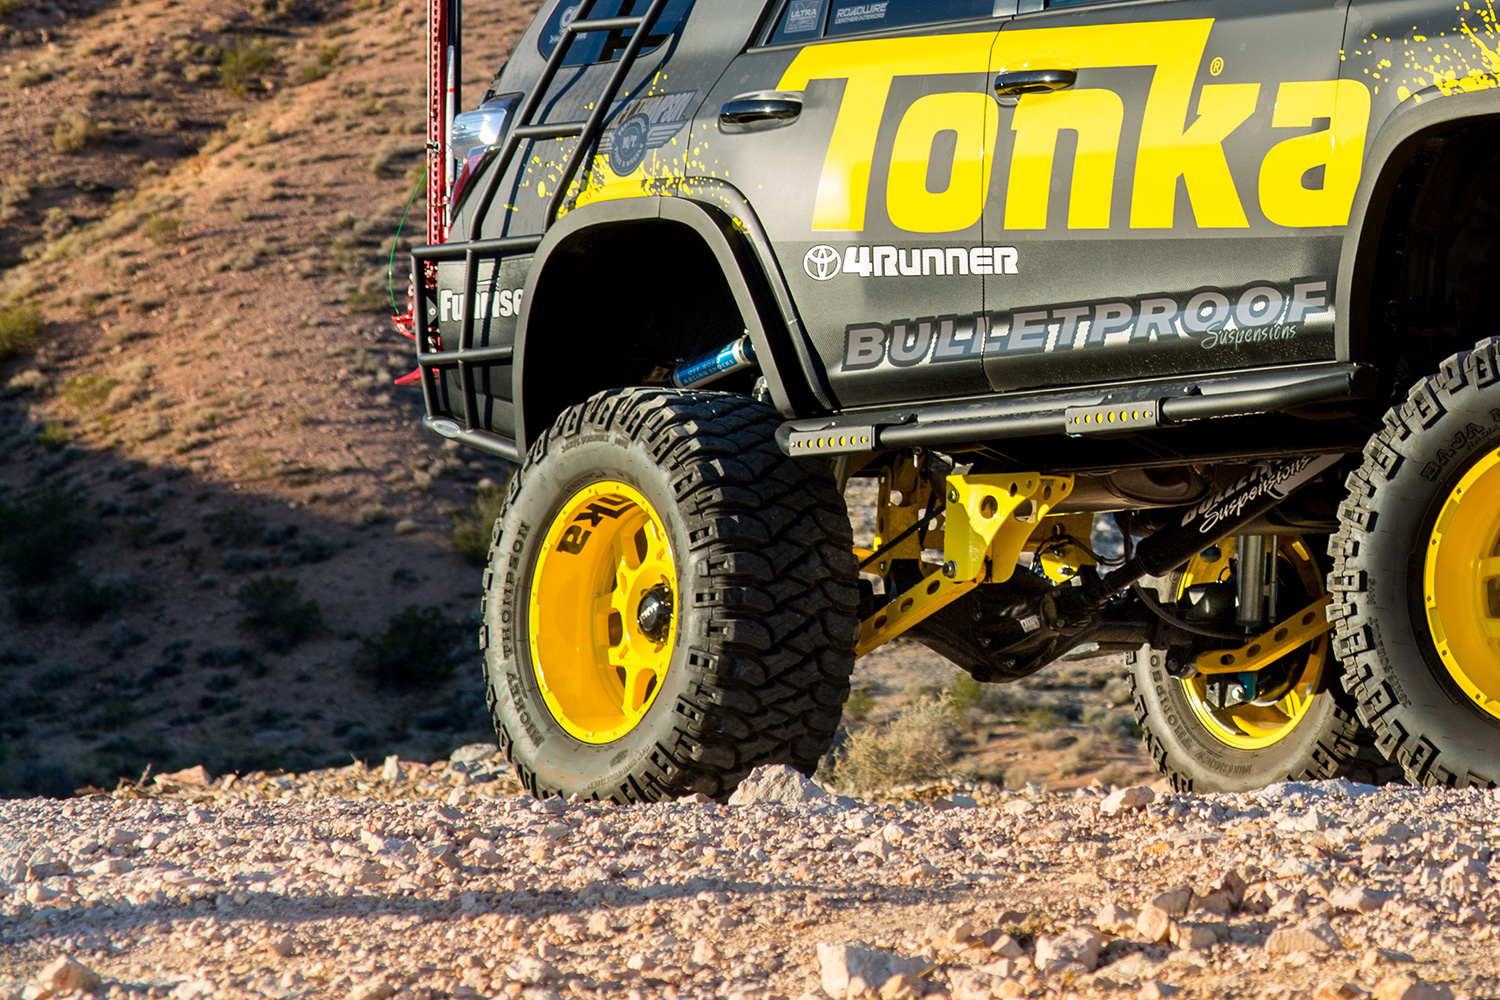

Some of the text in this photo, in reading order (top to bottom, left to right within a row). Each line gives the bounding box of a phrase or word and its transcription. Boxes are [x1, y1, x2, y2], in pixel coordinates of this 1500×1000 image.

[791, 8, 817, 18] ULTRA
[836, 1, 889, 17] ROADWIRE
[775, 18, 1371, 233] Tonka
[841, 279, 1337, 372] BULLETPROOF
[1201, 321, 1297, 351] Suspensions
[1420, 422, 1486, 482] BAJA
[1200, 455, 1313, 534] Suspensions
[501, 519, 530, 661] THOMPSON
[506, 671, 545, 748] MICKEY
[1149, 654, 1193, 752] THOMPSO
